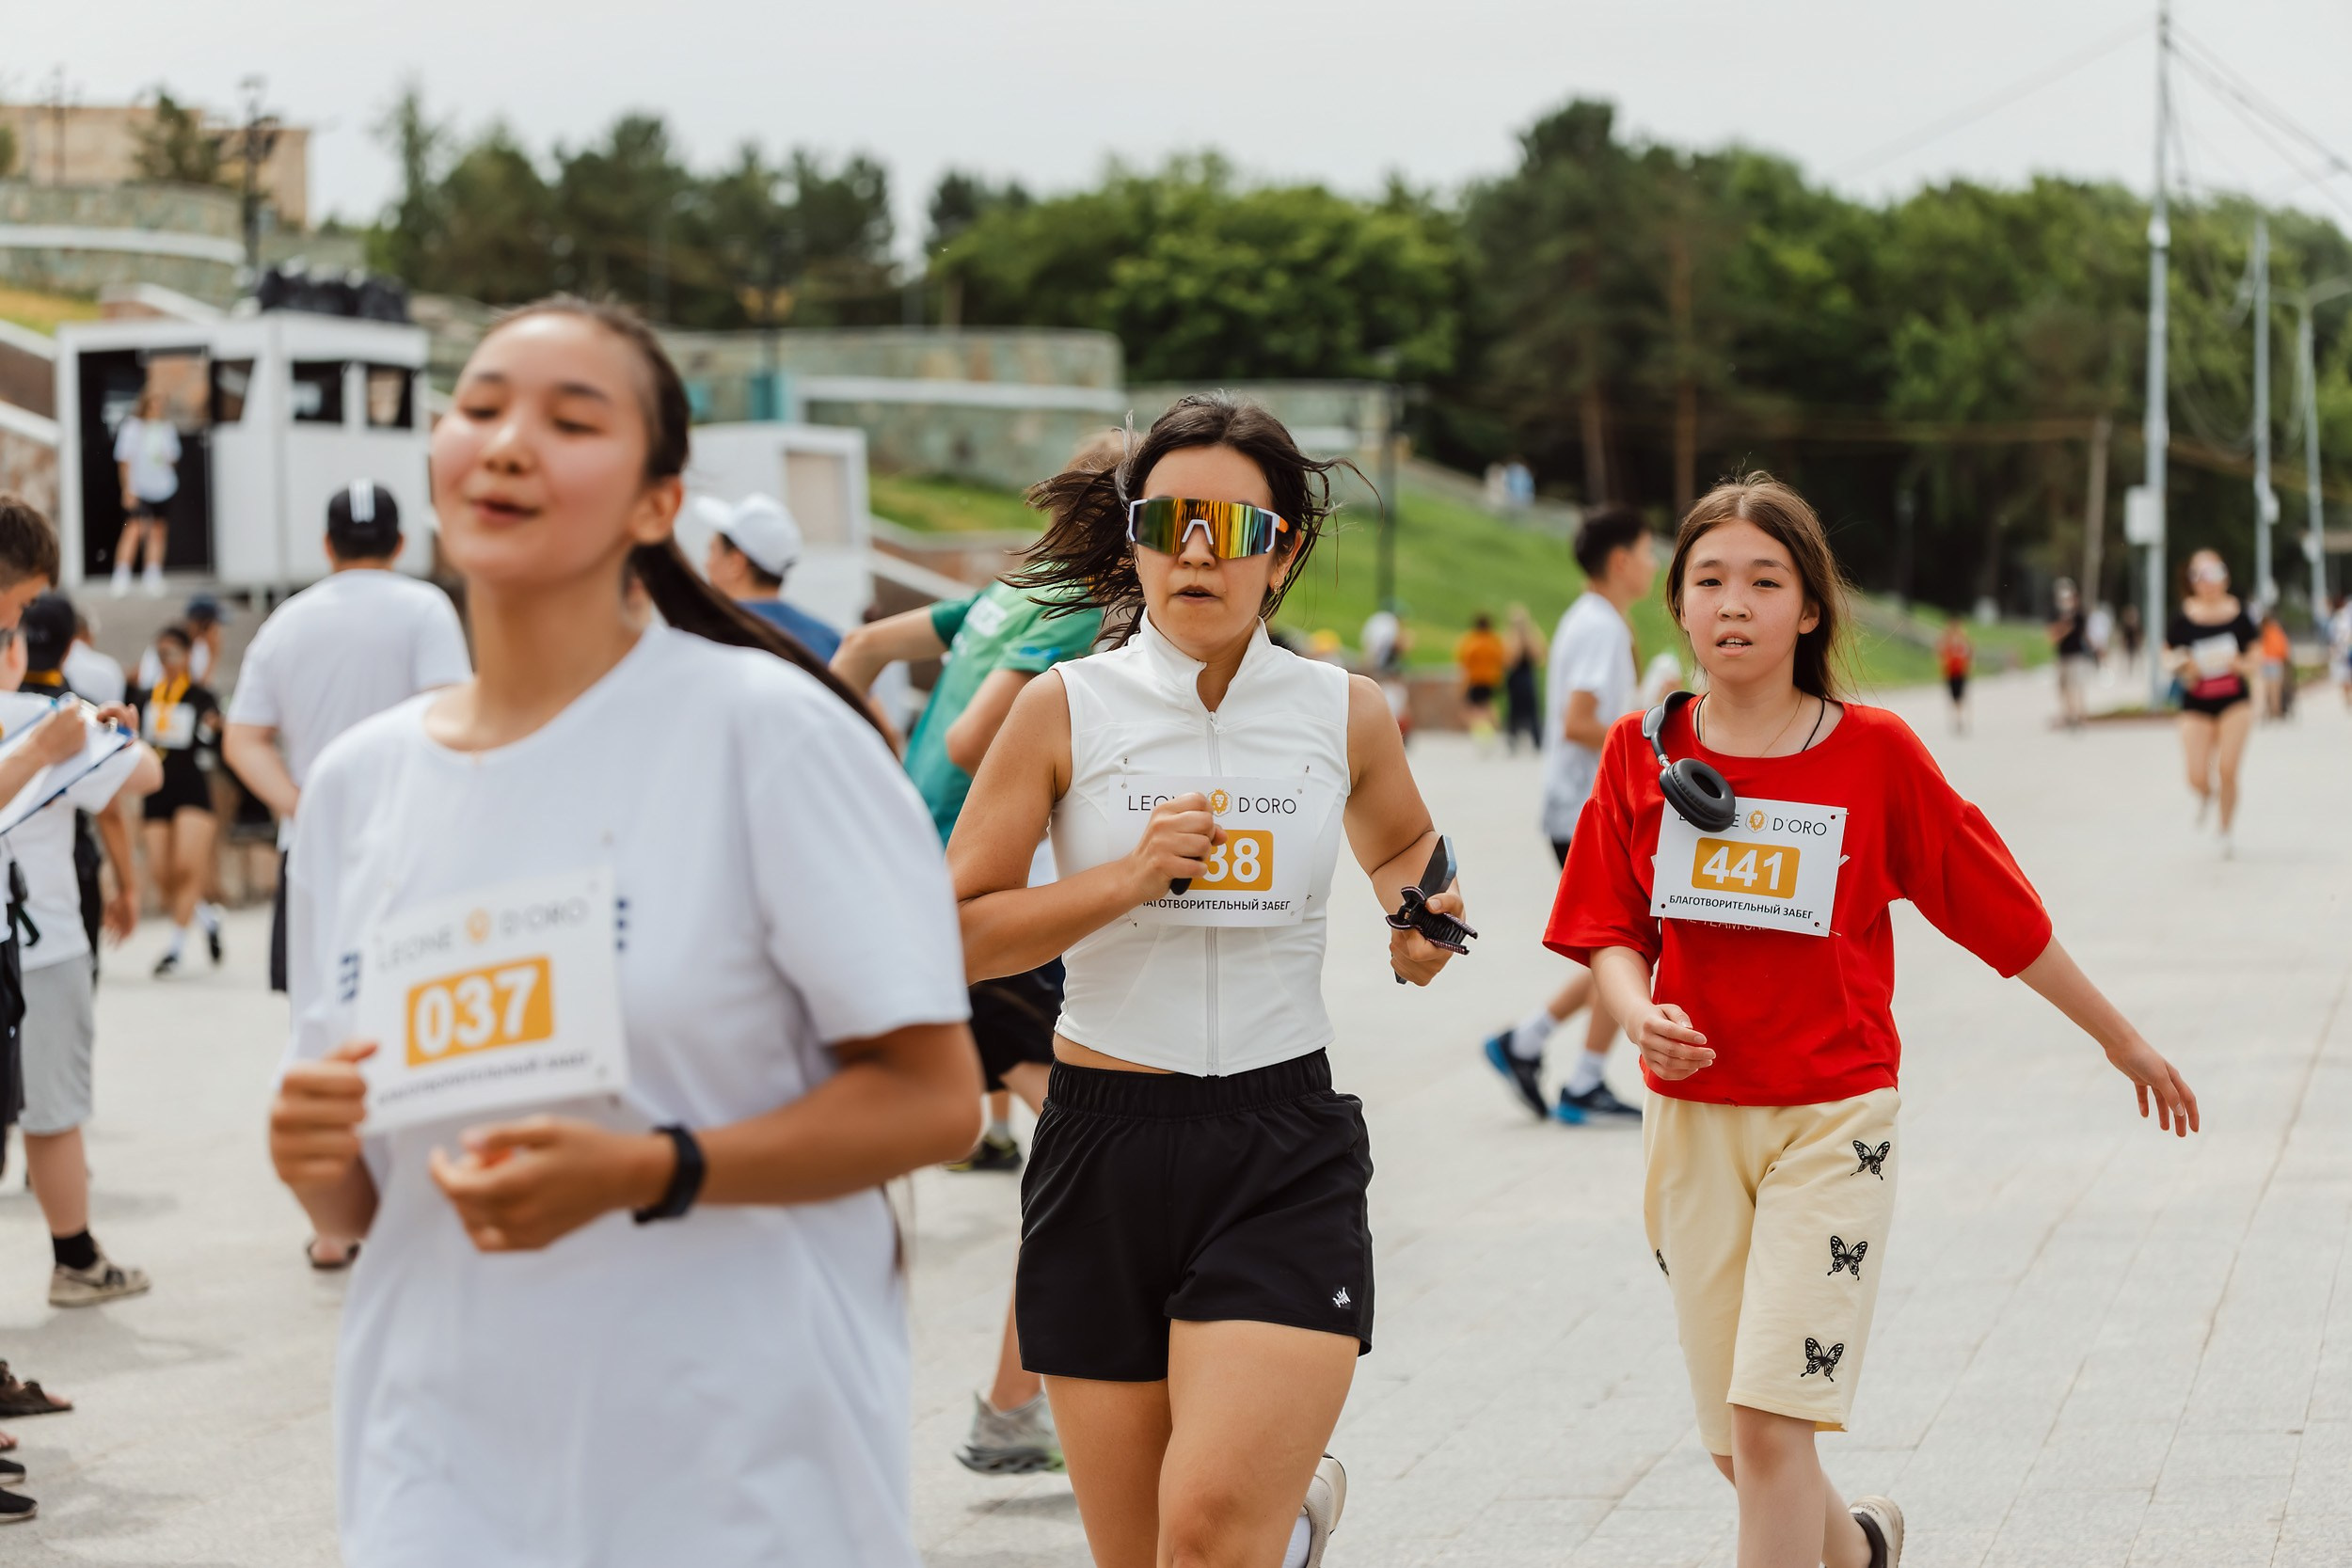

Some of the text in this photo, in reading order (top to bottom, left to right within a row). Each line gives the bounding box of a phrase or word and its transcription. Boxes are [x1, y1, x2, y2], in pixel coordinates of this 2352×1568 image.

[1238, 797, 1296, 815] D'ORO
[1772, 817, 1827, 836] D'ORO
[1203, 837, 1261, 883] 38
[1702, 846, 1783, 891] 441
[1143, 898, 1291, 911] АГОТВОРИТЕЛЬНЫЙ ЗАБЕГ
[1669, 895, 1814, 920] БЛАГОТВОРИТЕЛЬНЫЙ ЗАБЕГ
[414, 962, 539, 1057] 037
